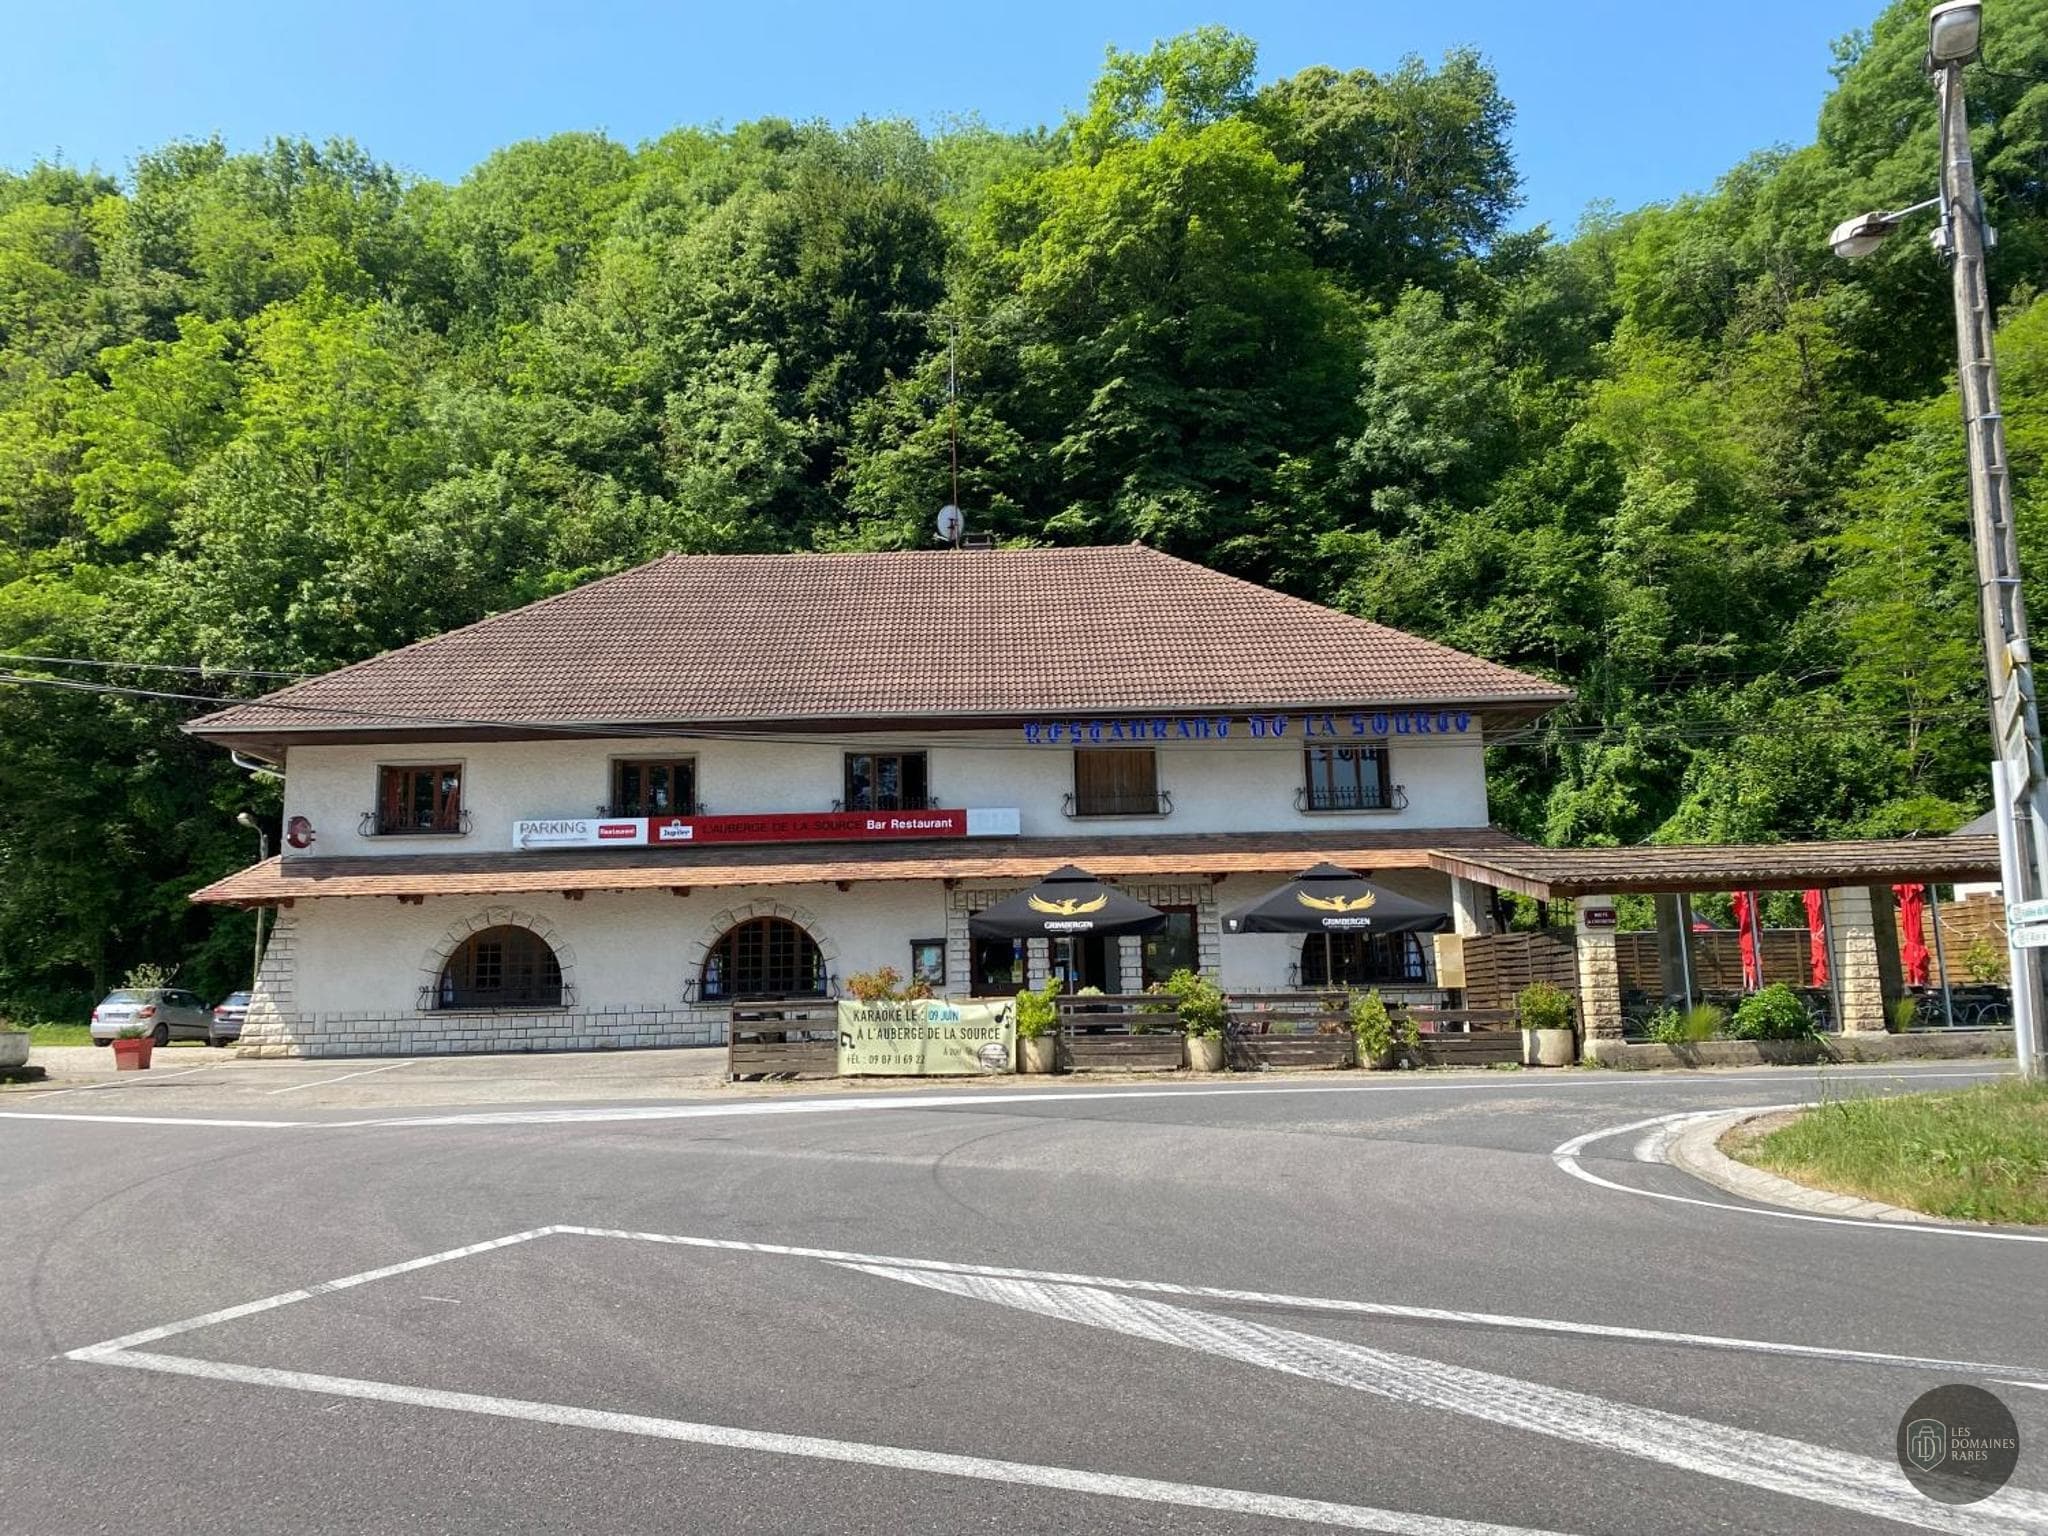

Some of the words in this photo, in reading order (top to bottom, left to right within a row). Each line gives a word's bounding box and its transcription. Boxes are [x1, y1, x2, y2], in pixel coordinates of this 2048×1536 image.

[519, 821, 587, 835] PARKING
[772, 822, 789, 833] DE
[793, 820, 808, 831] LA
[814, 819, 863, 831] SOURCE
[866, 818, 887, 830] Bar
[890, 818, 953, 829] Restaurant
[1321, 917, 1371, 926] GRIMBERGEN
[853, 1009, 902, 1022] KARAOKE
[905, 1009, 918, 1021] LE
[940, 1009, 960, 1021] JUIN
[867, 1027, 924, 1040] L'AUBERGE
[927, 1027, 941, 1040] DE
[944, 1027, 957, 1040] LA
[960, 1027, 1001, 1040] SOURCE
